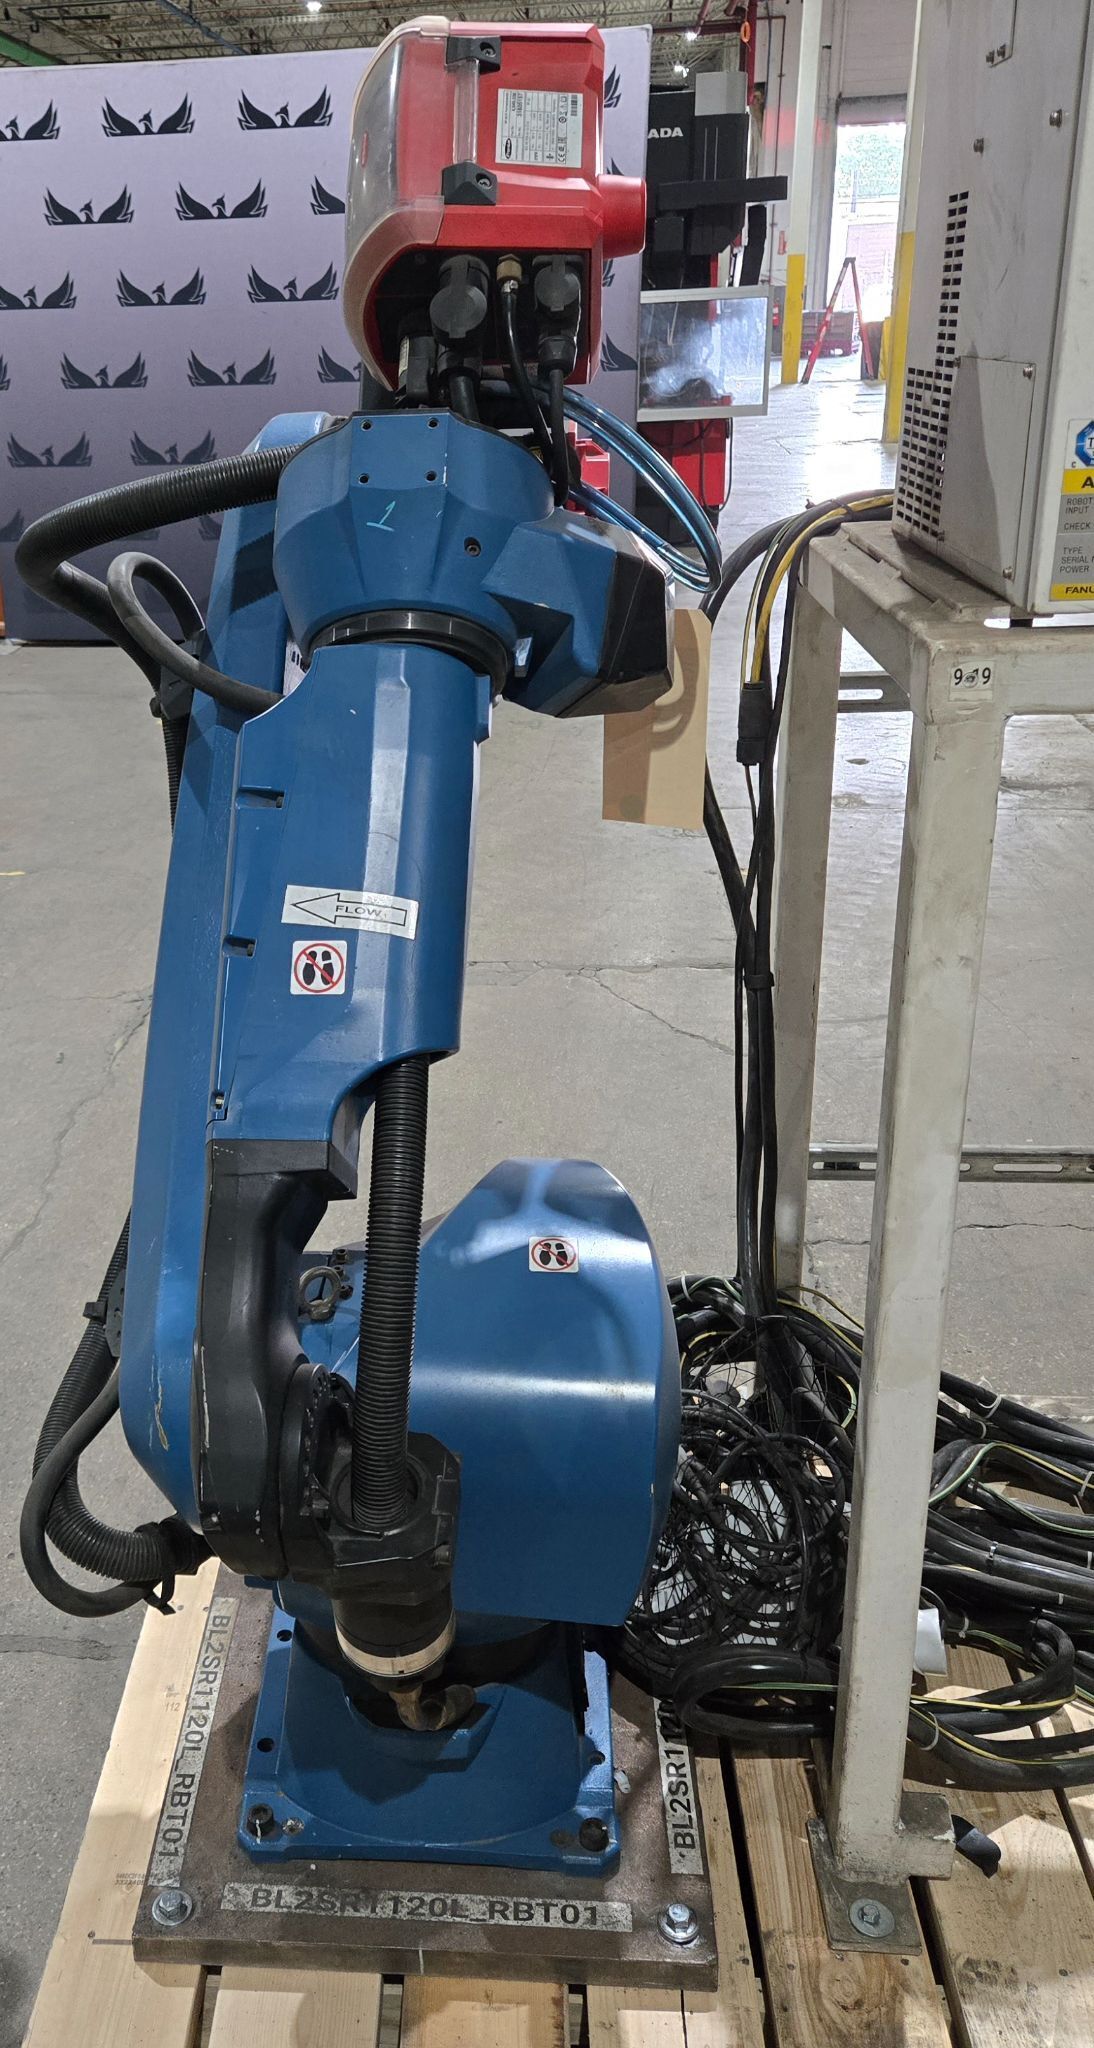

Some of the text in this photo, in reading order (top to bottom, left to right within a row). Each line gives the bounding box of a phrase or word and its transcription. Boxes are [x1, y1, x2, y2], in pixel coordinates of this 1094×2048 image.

[1067, 497, 1092, 506] ROBOT
[1065, 505, 1089, 514] INPUT
[1063, 521, 1090, 530] CHECK
[1063, 546, 1082, 554] TYPE
[1061, 555, 1088, 564] SERIAL
[1059, 565, 1089, 574] POWER
[335, 905, 381, 916] FLOW
